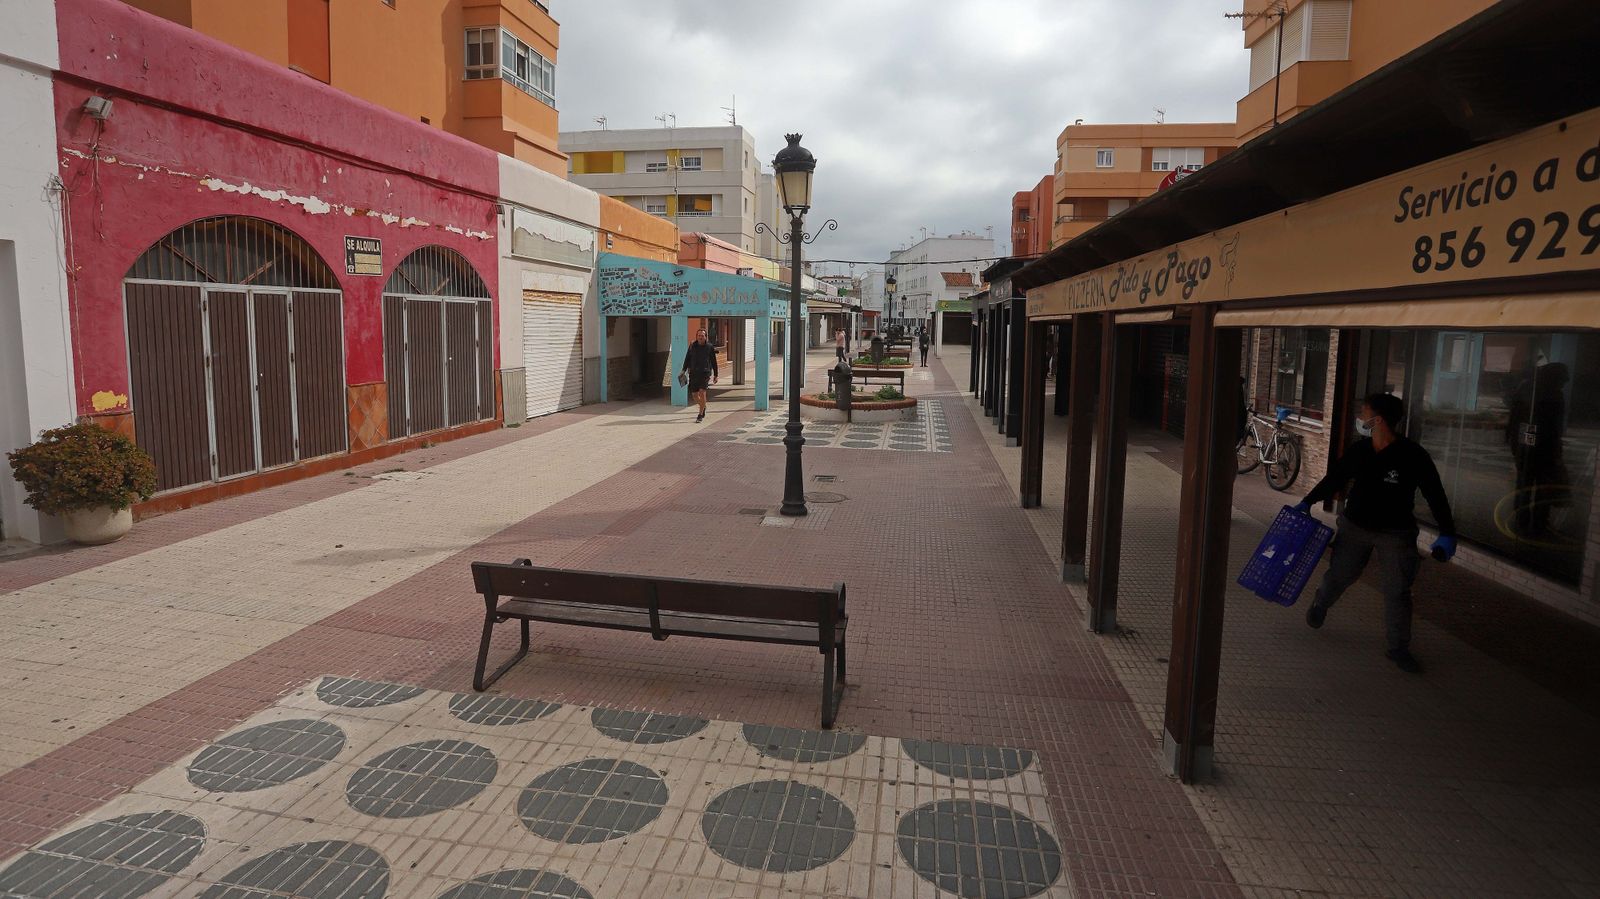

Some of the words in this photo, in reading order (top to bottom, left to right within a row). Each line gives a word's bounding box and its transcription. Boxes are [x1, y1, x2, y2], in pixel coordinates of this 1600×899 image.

[1394, 163, 1518, 223] Servicio
[1532, 157, 1560, 193] a
[346, 239, 355, 251] SE
[356, 240, 380, 252] ALQUILA
[1411, 226, 1486, 274] 856
[1505, 203, 1600, 264] 929
[1068, 275, 1106, 310] PIZZERIA
[1109, 263, 1139, 303] Pido
[1138, 268, 1153, 304] y
[1154, 251, 1212, 300] Pago
